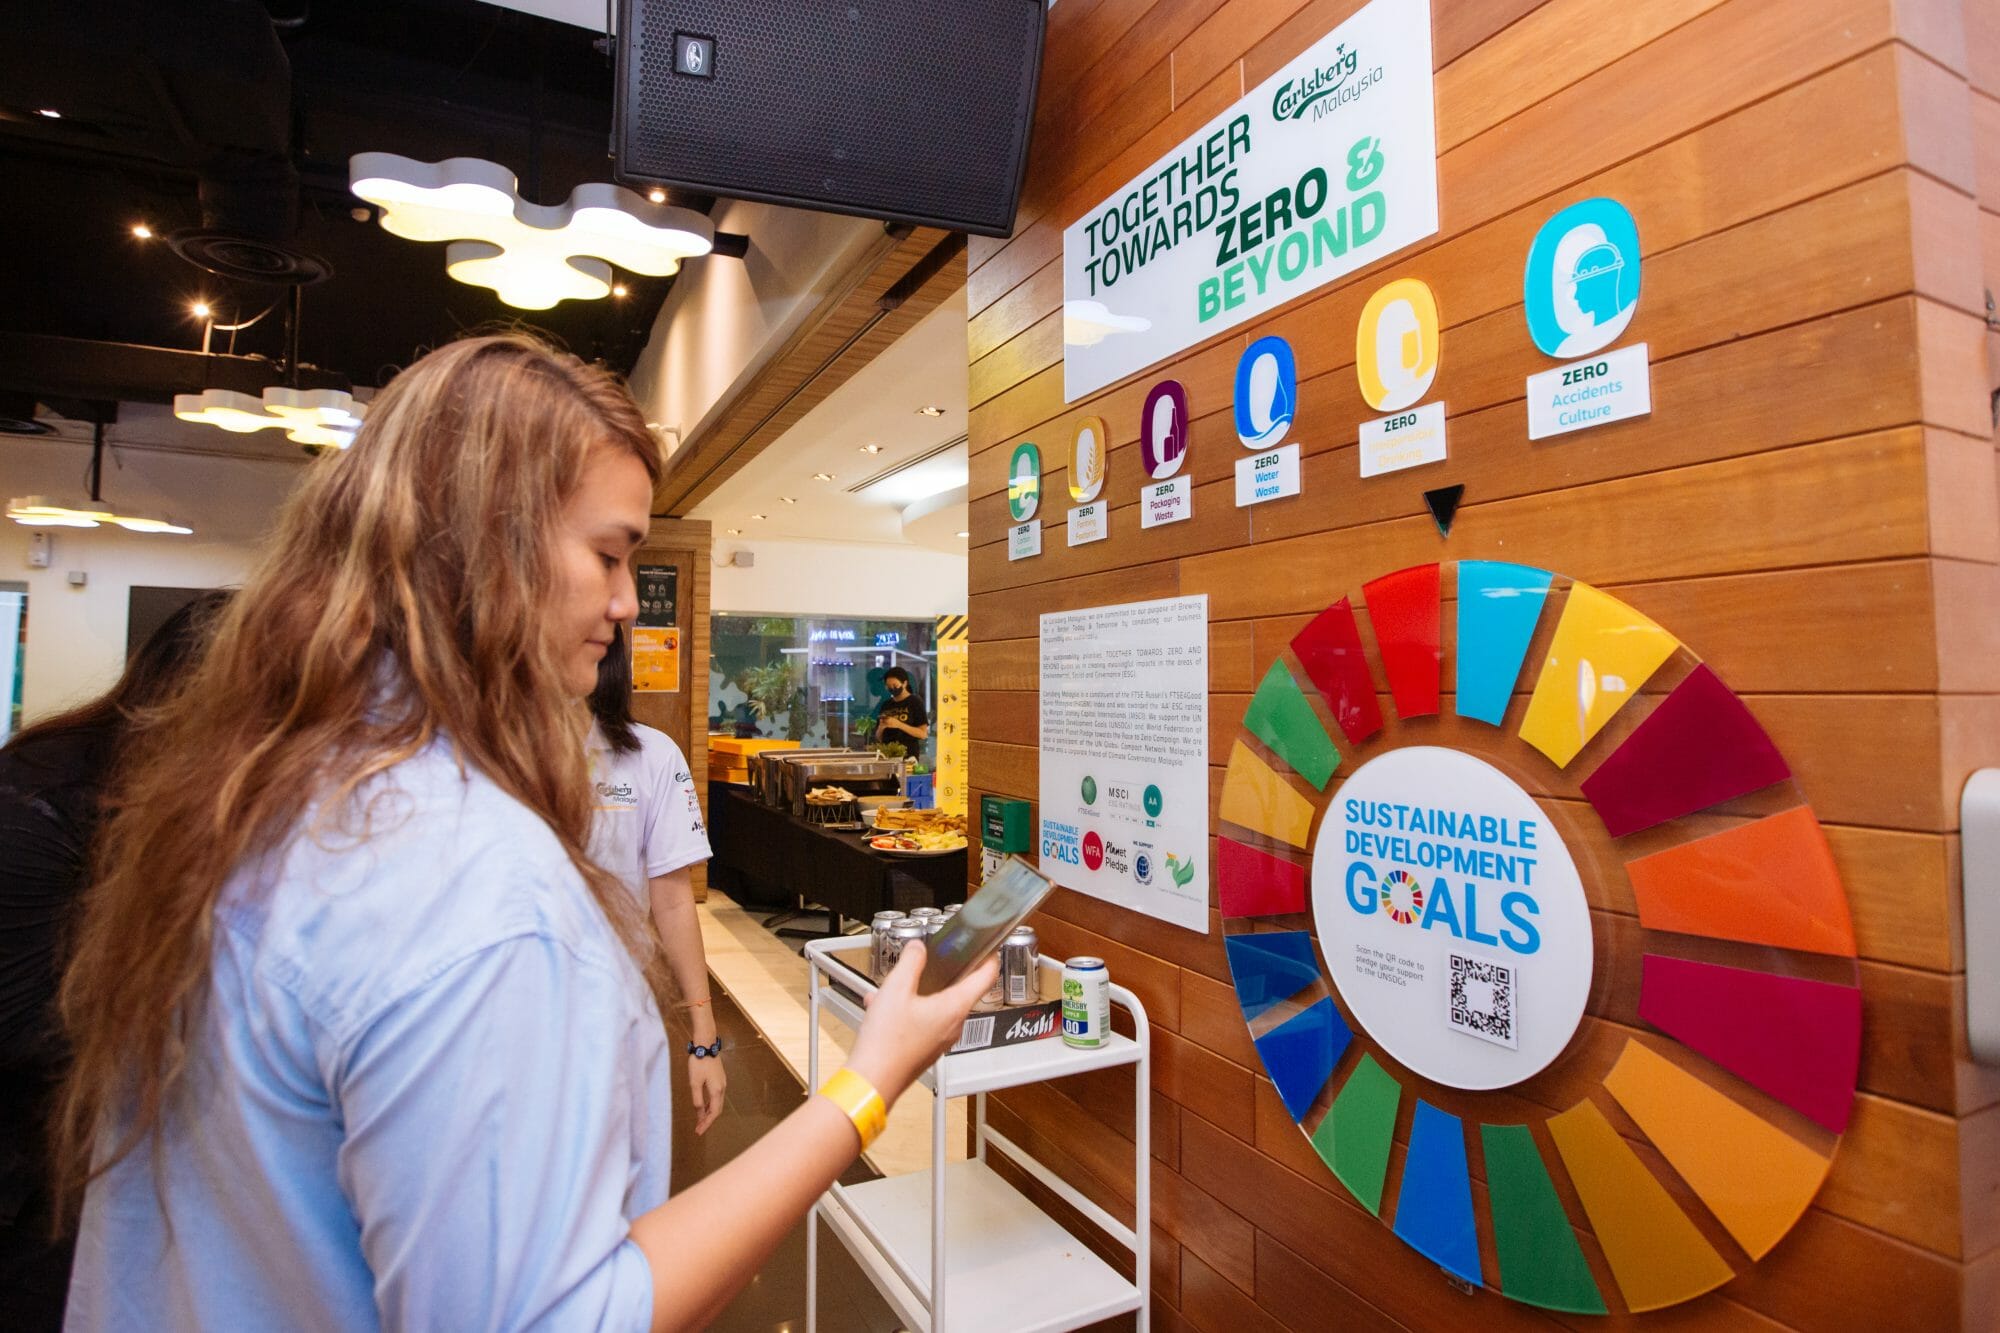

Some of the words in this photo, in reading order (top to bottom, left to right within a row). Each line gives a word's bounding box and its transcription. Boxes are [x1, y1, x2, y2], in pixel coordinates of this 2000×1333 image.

[1273, 45, 1357, 122] Carlsberg
[1312, 65, 1383, 123] Malaysia
[1084, 113, 1251, 258] TOGETHER
[1216, 167, 1328, 267] ZERO
[1346, 136, 1385, 191] &
[1084, 169, 1240, 297] TOWARDS
[1198, 190, 1386, 323] BEYOND
[1562, 361, 1608, 386] ZERO
[1552, 379, 1622, 409] Accidents
[1384, 413, 1417, 432] ZERO
[1559, 403, 1611, 426] Culture
[1254, 454, 1279, 470] ZERO
[1255, 469, 1279, 483] Water
[1156, 484, 1174, 496] ZERO
[1255, 483, 1280, 498] Waste
[1079, 507, 1094, 517] ZERO
[1150, 496, 1181, 510] Packaging
[1155, 510, 1174, 521] Waste
[1018, 524, 1030, 535] ZERO
[596, 782, 632, 797] Carlsberg
[1108, 787, 1129, 800] MSCI
[1149, 796, 1157, 806] AA
[1043, 819, 1079, 835] SUSTAINABLE
[1345, 798, 1537, 850] SUSTAINABLE
[1043, 830, 1079, 844] DEVELOPMENT
[1043, 840, 1079, 865] GOALS
[1085, 845, 1100, 858] WFA
[1106, 841, 1127, 858] Planet
[1345, 830, 1537, 886] DEVELOPMENT
[1106, 858, 1128, 873] Pledge
[1345, 861, 1541, 955] GOALS
[1356, 944, 1371, 954] Scan
[1373, 950, 1383, 959] the
[1386, 952, 1396, 963] QR
[1399, 959, 1414, 968] code
[1417, 963, 1424, 971] to
[1356, 956, 1377, 968] pledge
[1380, 963, 1394, 971] your
[1397, 968, 1423, 981] support
[1365, 968, 1375, 976] the
[1378, 972, 1406, 986] UNSDGs
[1006, 1011, 1054, 1040] Asahi
